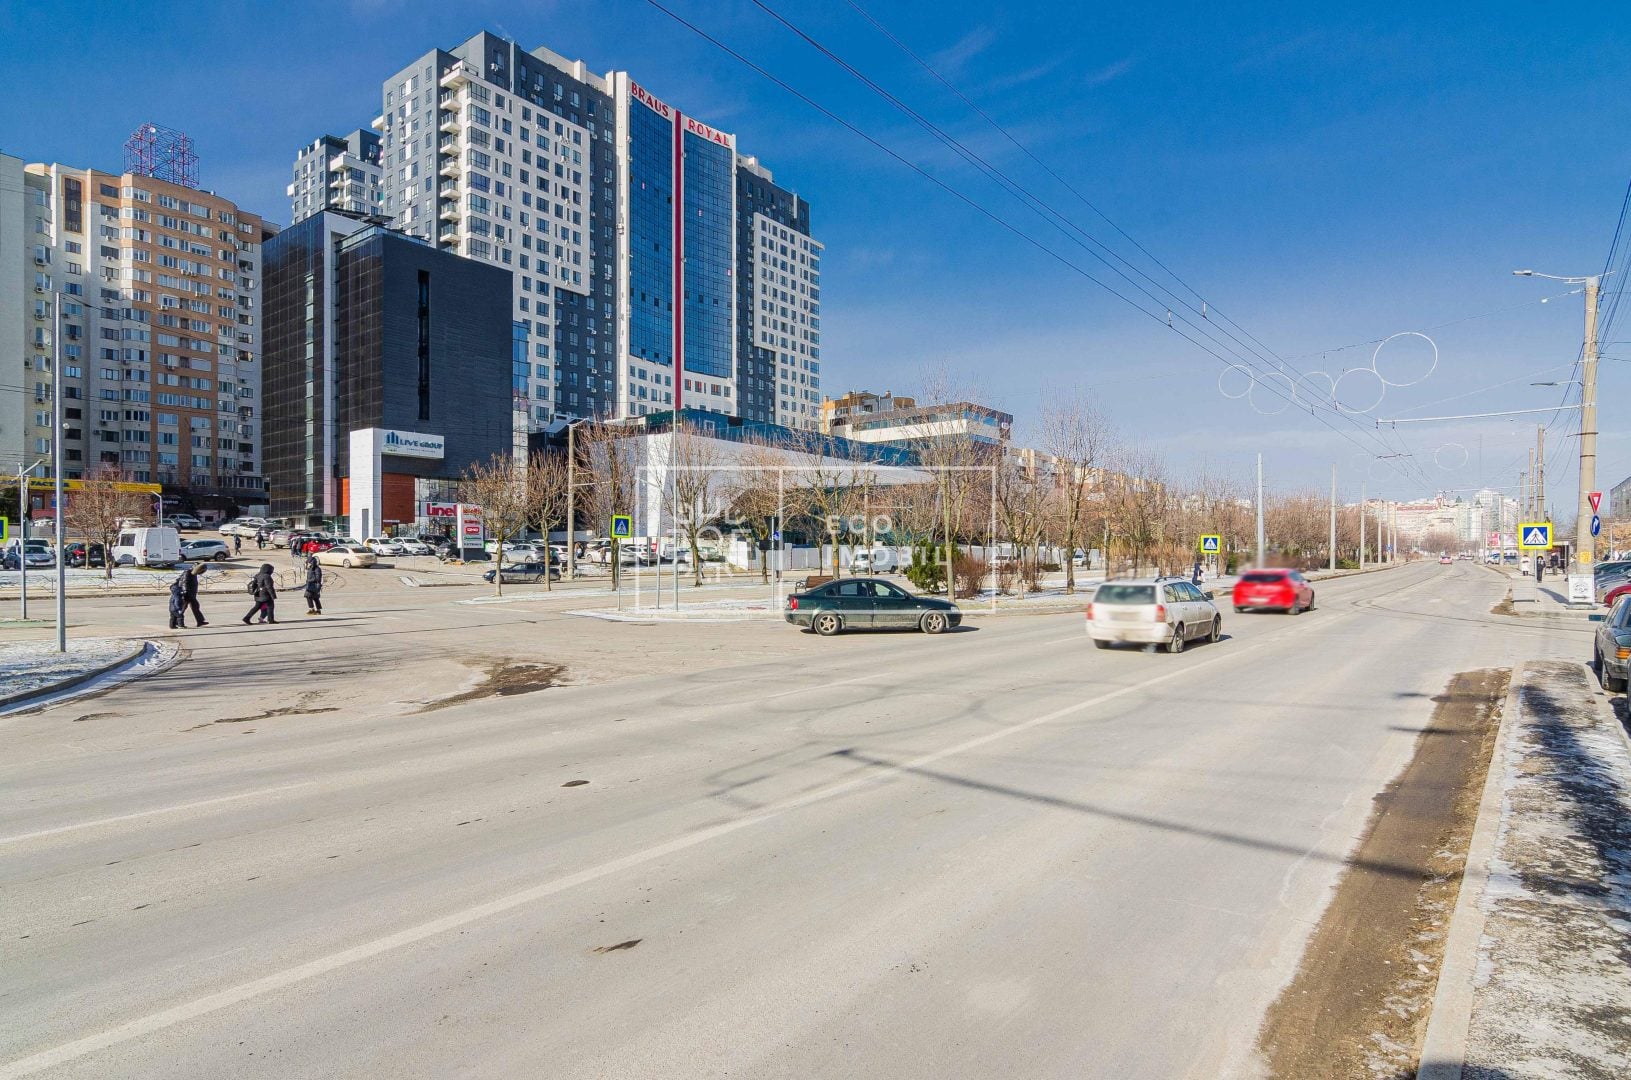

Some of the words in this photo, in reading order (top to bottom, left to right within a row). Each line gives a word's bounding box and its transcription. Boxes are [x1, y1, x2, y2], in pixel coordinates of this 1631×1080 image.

[631, 81, 669, 117] BRAUS
[687, 118, 730, 147] ROYAL
[400, 439, 419, 447] LIVE
